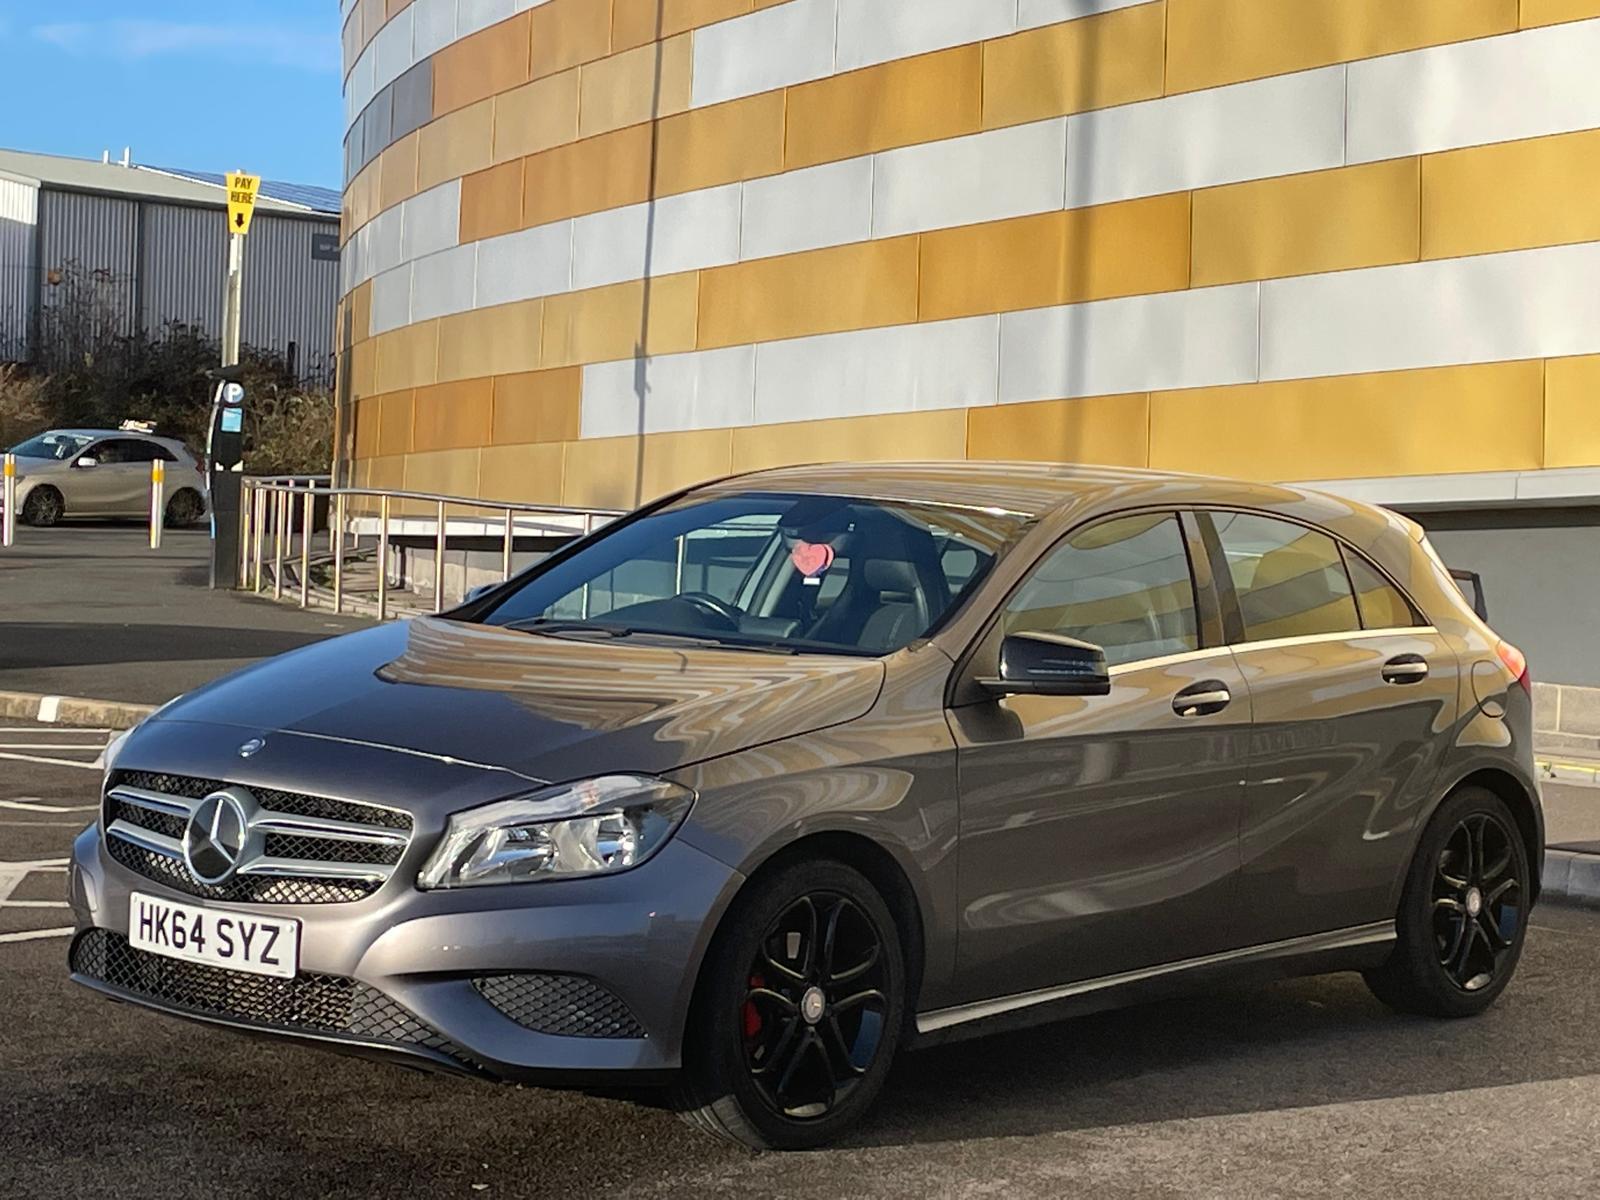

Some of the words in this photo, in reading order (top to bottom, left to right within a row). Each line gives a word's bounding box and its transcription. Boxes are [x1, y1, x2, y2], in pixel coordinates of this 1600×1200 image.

[234, 176, 252, 189] PAY
[230, 191, 253, 204] HERE
[139, 901, 206, 953] HK64
[216, 918, 280, 965] SYZ
